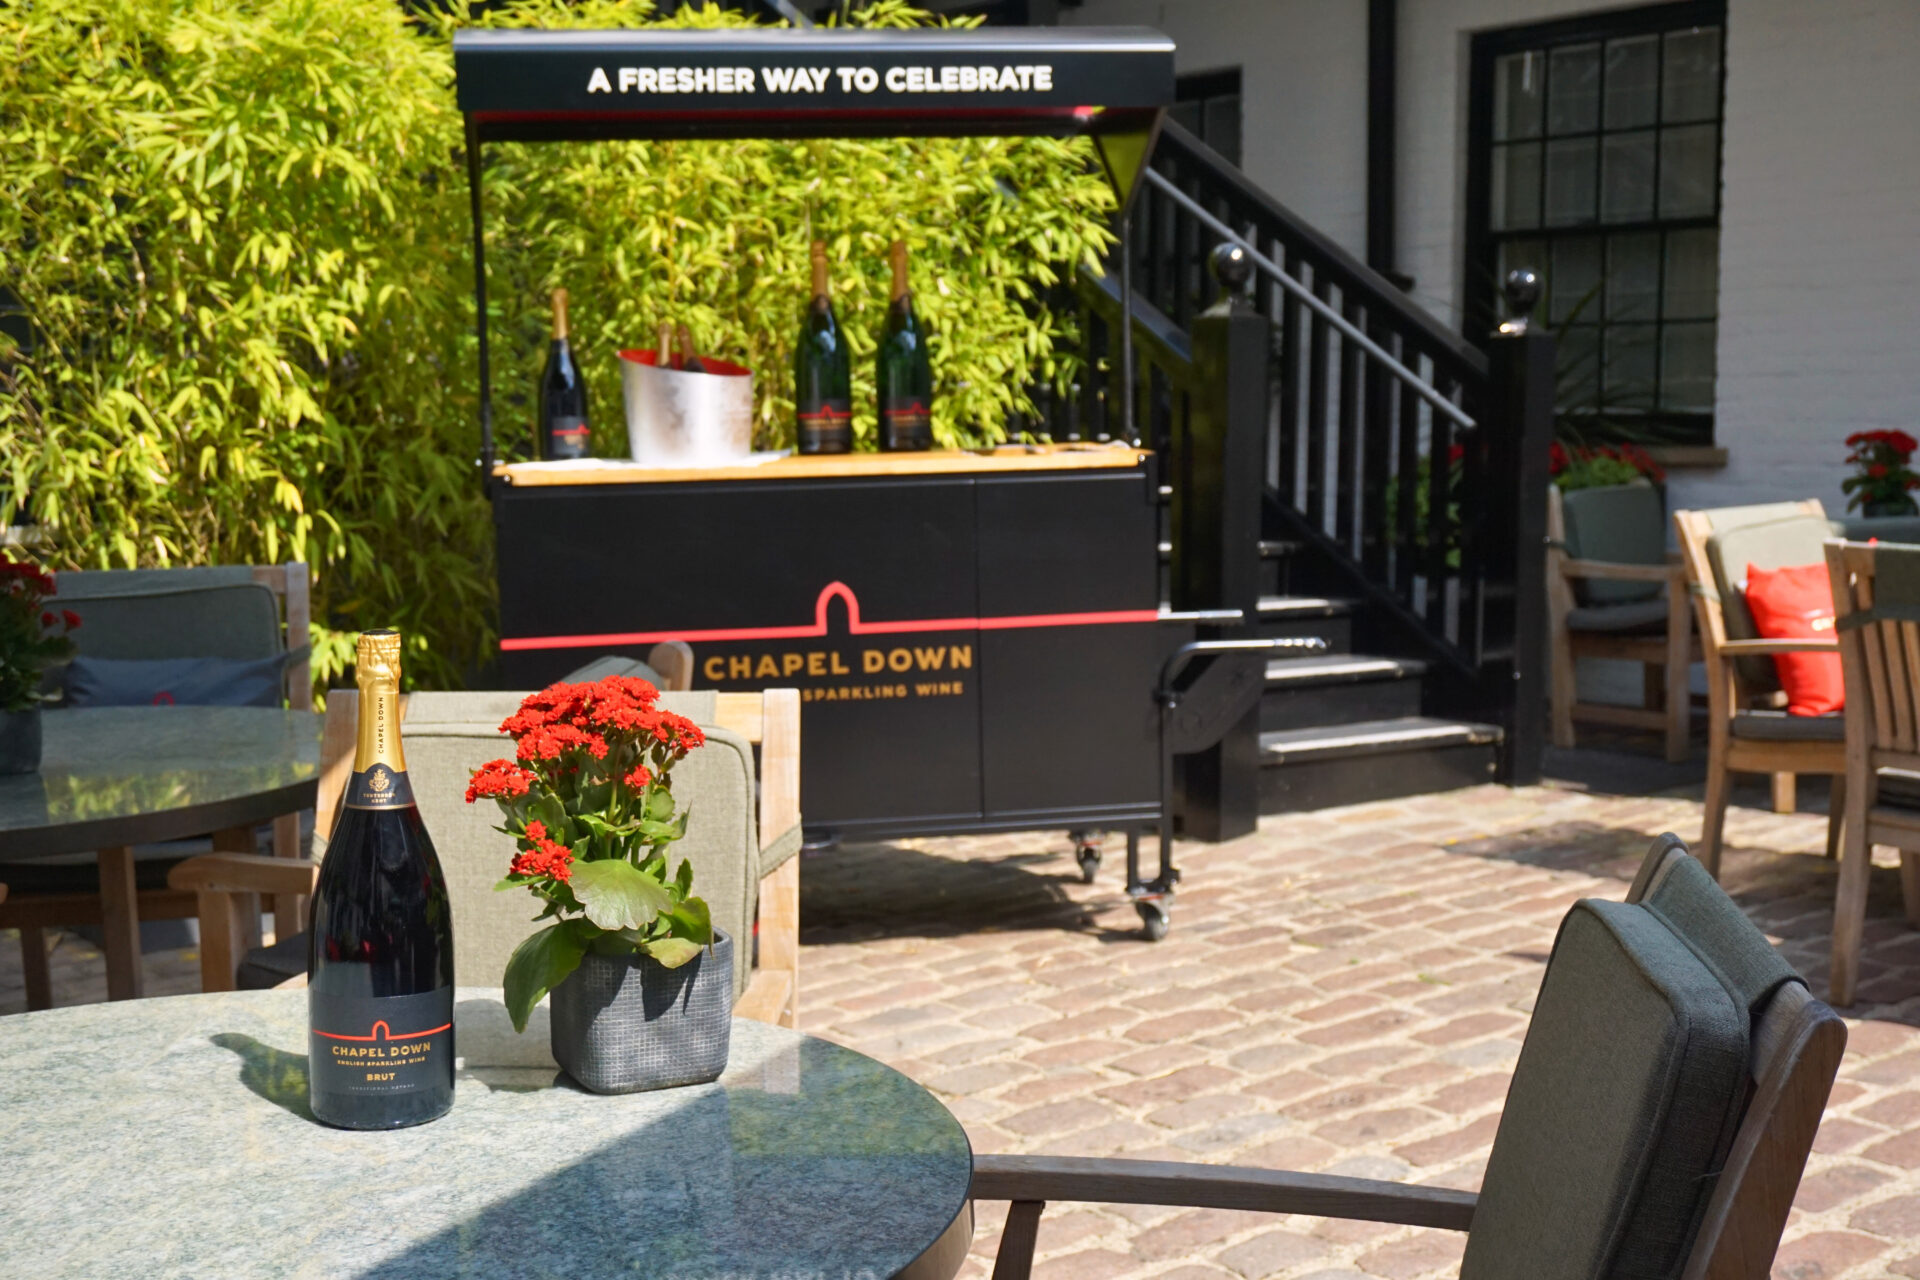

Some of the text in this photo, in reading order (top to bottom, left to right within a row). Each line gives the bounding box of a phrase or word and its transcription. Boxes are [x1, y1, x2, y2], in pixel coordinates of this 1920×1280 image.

[587, 65, 1053, 93] A FRESHER WAY TO CELEBRATE
[704, 645, 973, 680] CHAPEL DOWN
[802, 681, 964, 702] SPARKLING WINE
[332, 1041, 431, 1058] CHAPEL DOWN
[366, 1072, 395, 1081] BRUT
